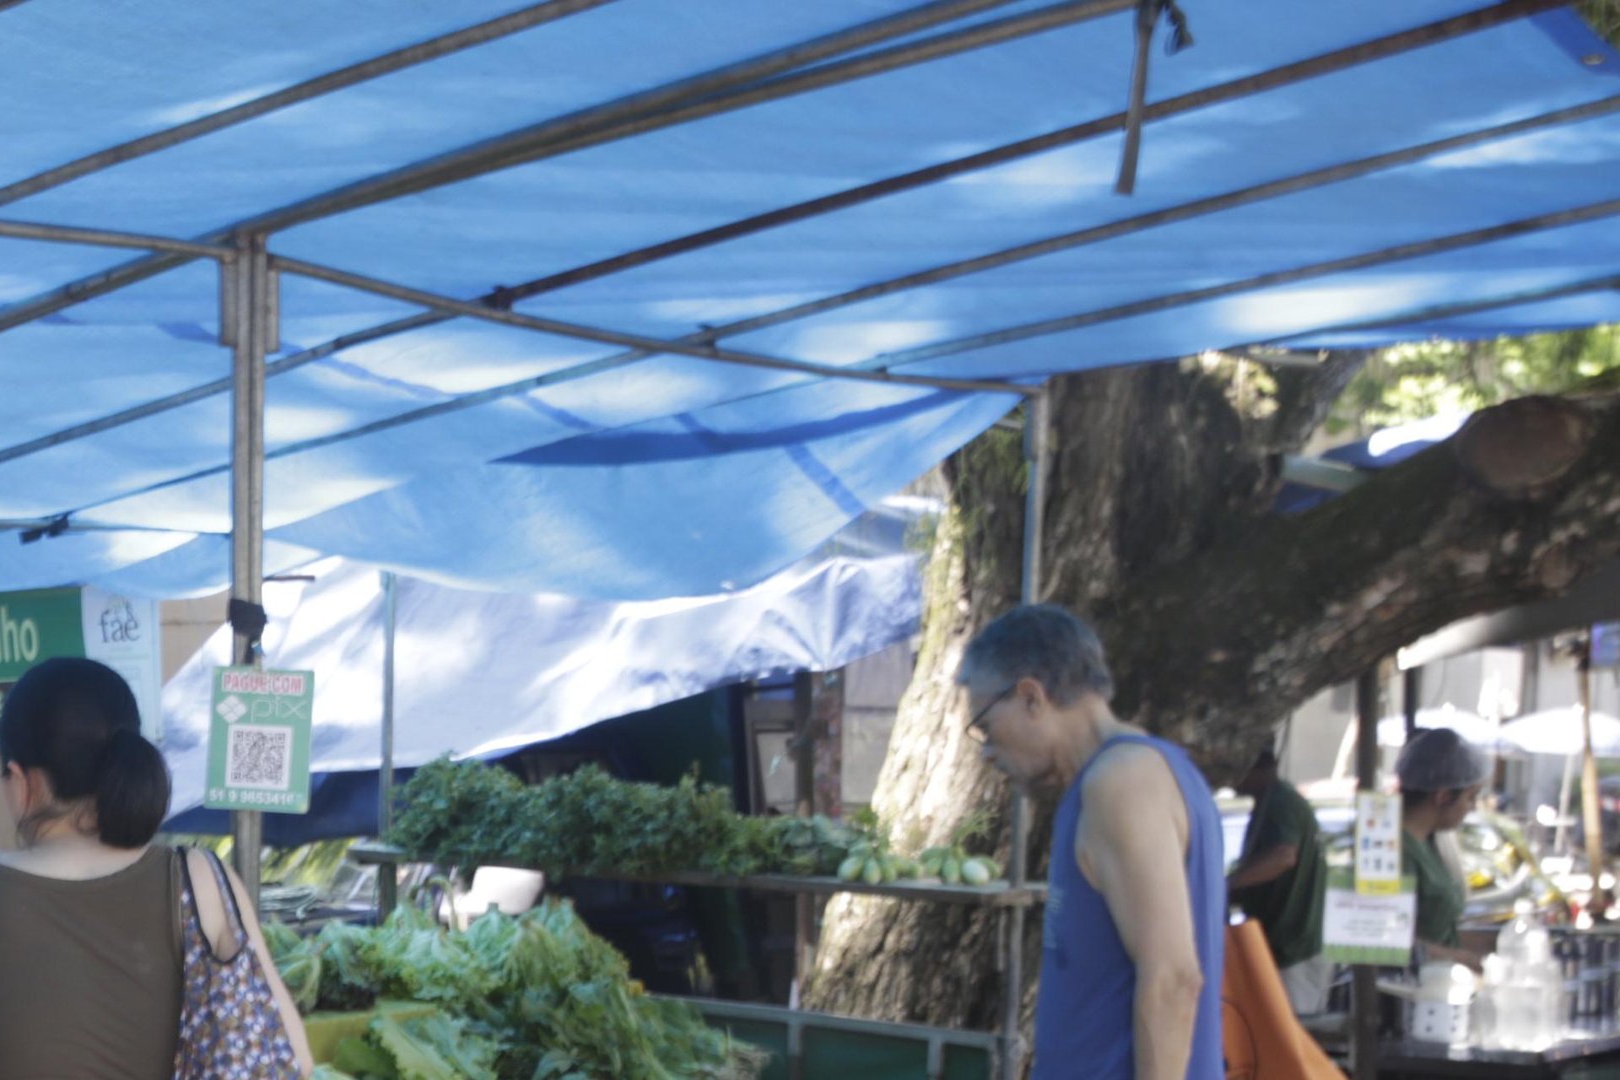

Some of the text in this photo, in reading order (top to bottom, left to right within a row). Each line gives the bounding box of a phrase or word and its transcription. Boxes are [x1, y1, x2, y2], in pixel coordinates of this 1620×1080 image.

[223, 672, 304, 696] PAGUE COM
[250, 695, 308, 723] pix
[228, 789, 238, 802] 9
